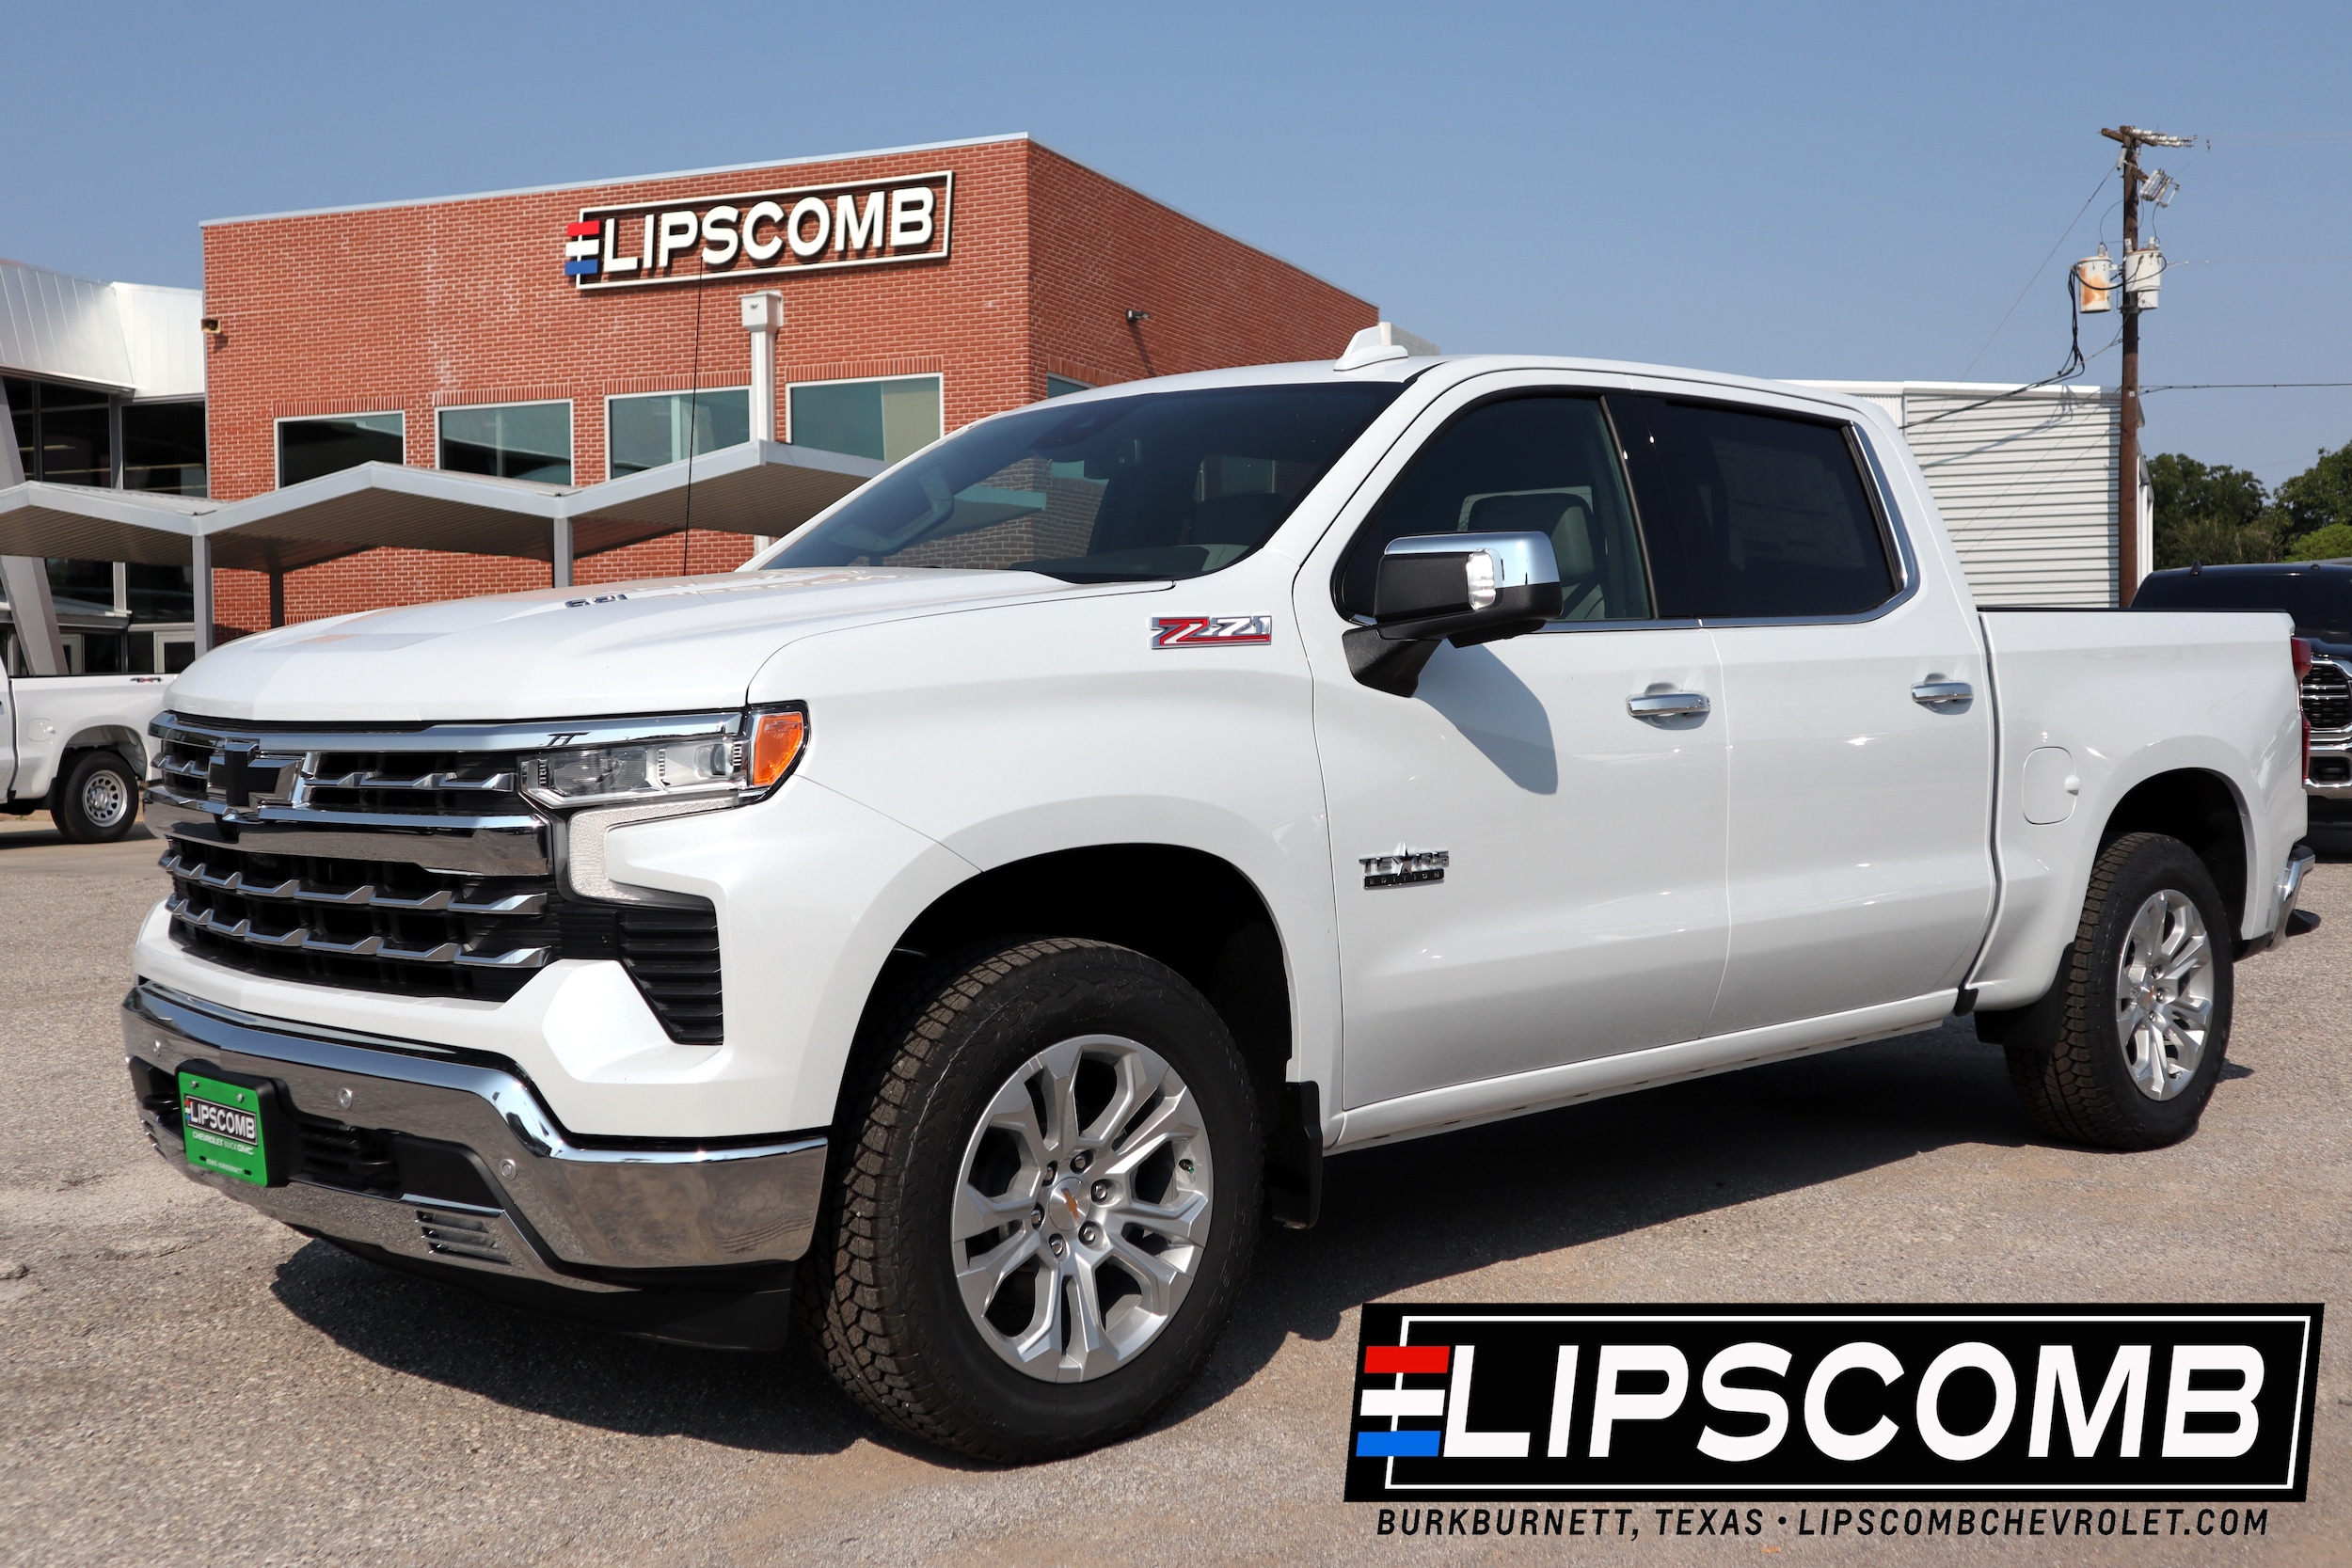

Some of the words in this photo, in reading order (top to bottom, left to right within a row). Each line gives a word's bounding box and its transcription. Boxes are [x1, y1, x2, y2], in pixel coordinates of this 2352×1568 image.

[603, 186, 935, 273] LIPSCOMB
[1151, 615, 1272, 650] Z71
[190, 1101, 256, 1140] LIPSCOMB
[192, 1131, 224, 1147] CHEVROLET
[237, 1144, 255, 1156] GMC
